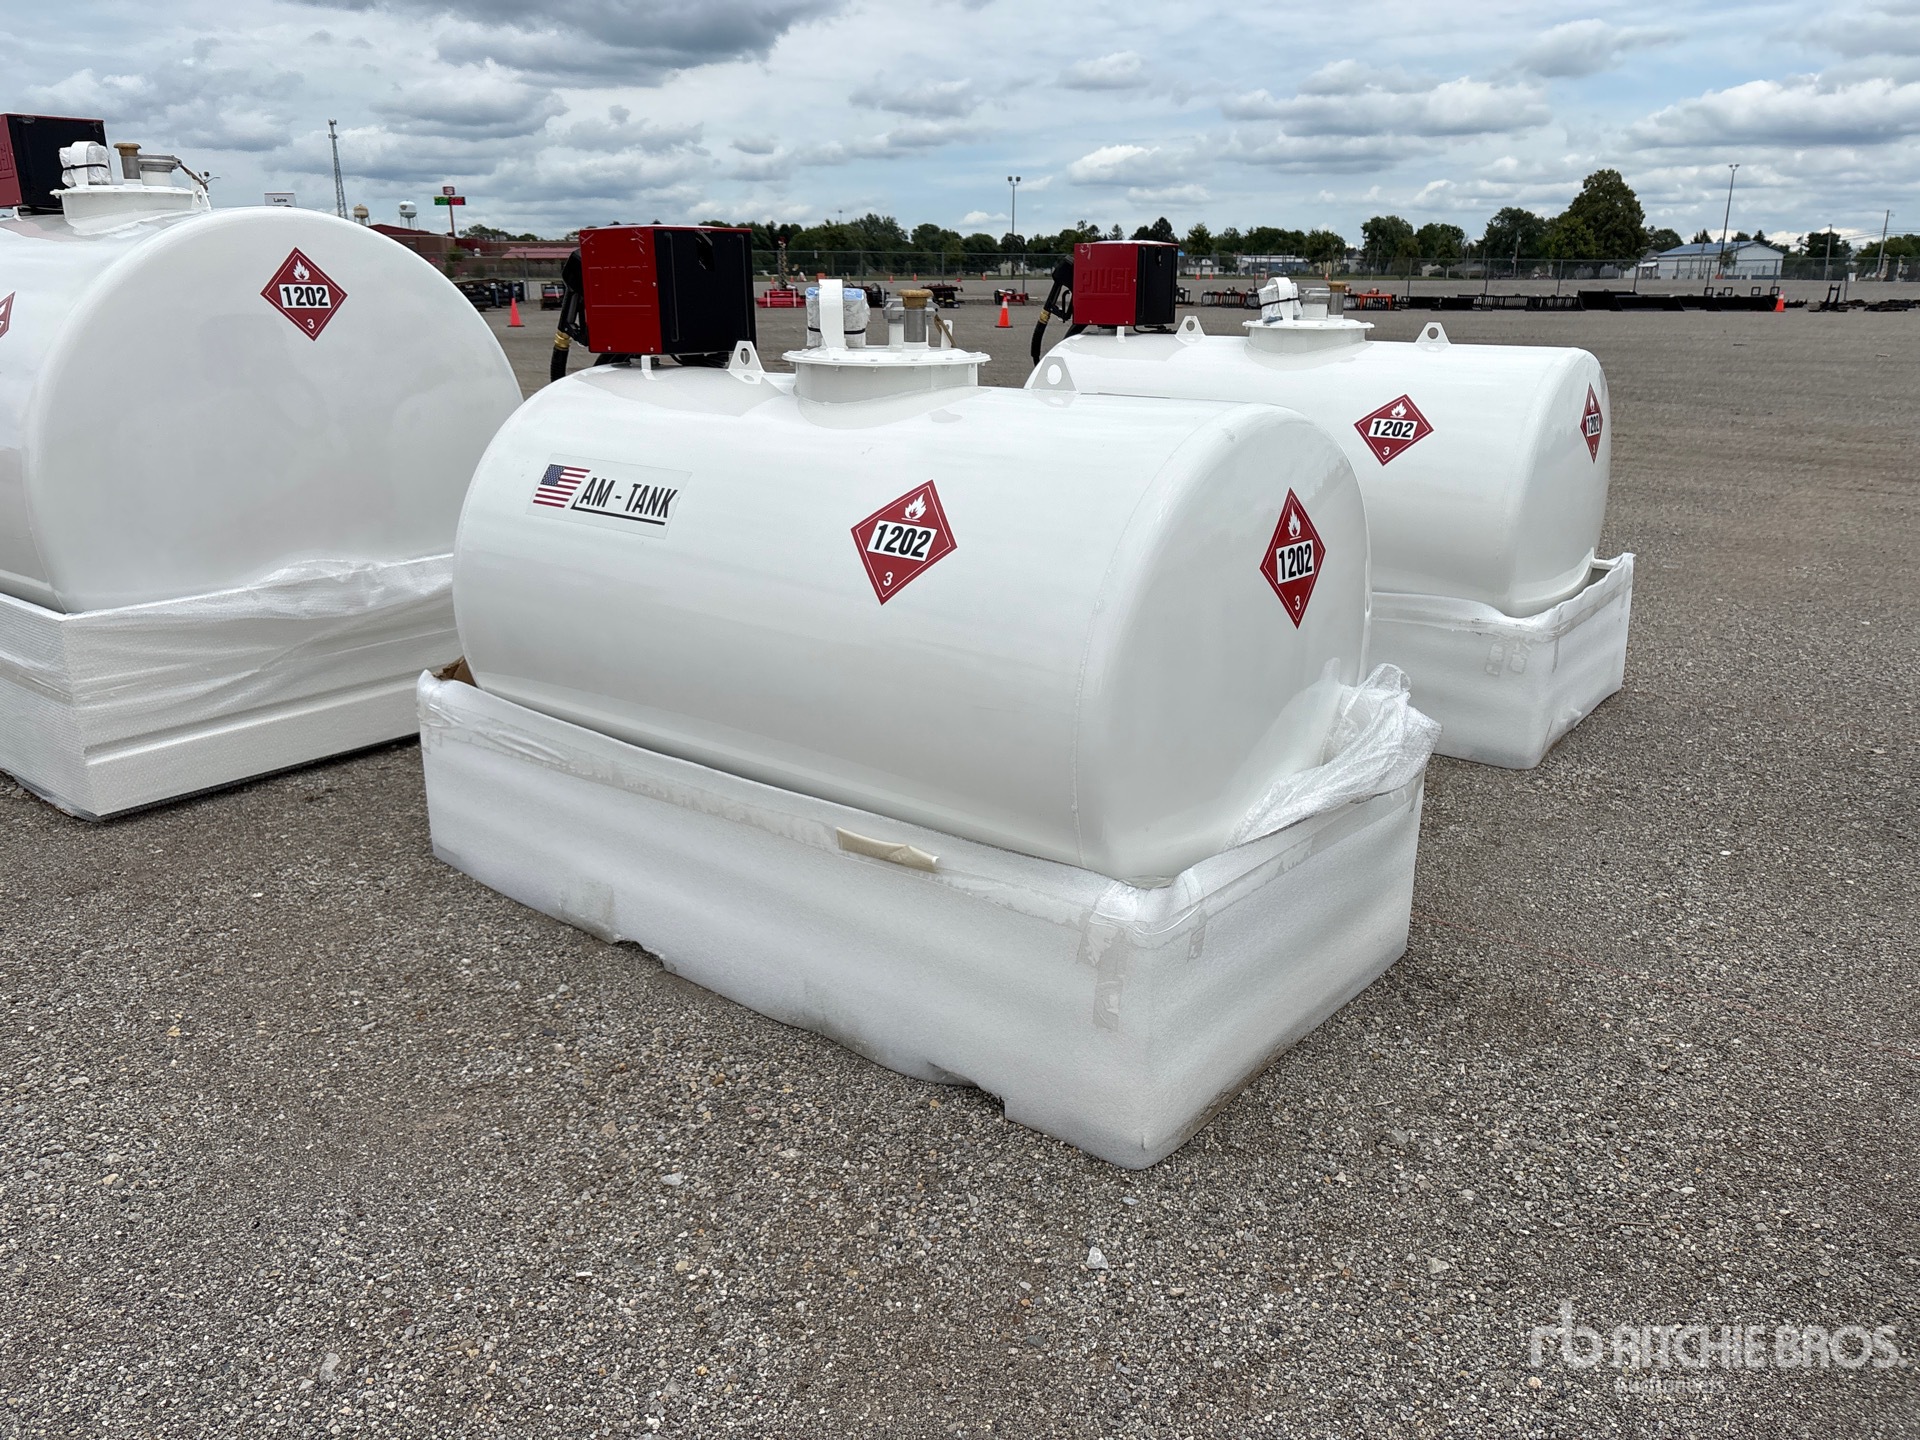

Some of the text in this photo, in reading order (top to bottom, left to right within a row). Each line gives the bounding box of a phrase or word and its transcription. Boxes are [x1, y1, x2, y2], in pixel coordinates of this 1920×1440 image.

[282, 286, 329, 307] 1202
[307, 318, 315, 330] 3
[1373, 420, 1415, 438] 1202
[1587, 415, 1600, 435] 1202
[1383, 446, 1391, 456] 3
[579, 477, 616, 508] AM
[625, 483, 678, 519] TANK
[874, 523, 932, 558] 1202
[1278, 543, 1313, 580] 1202
[883, 571, 894, 587] 3
[1294, 595, 1301, 611] 3
